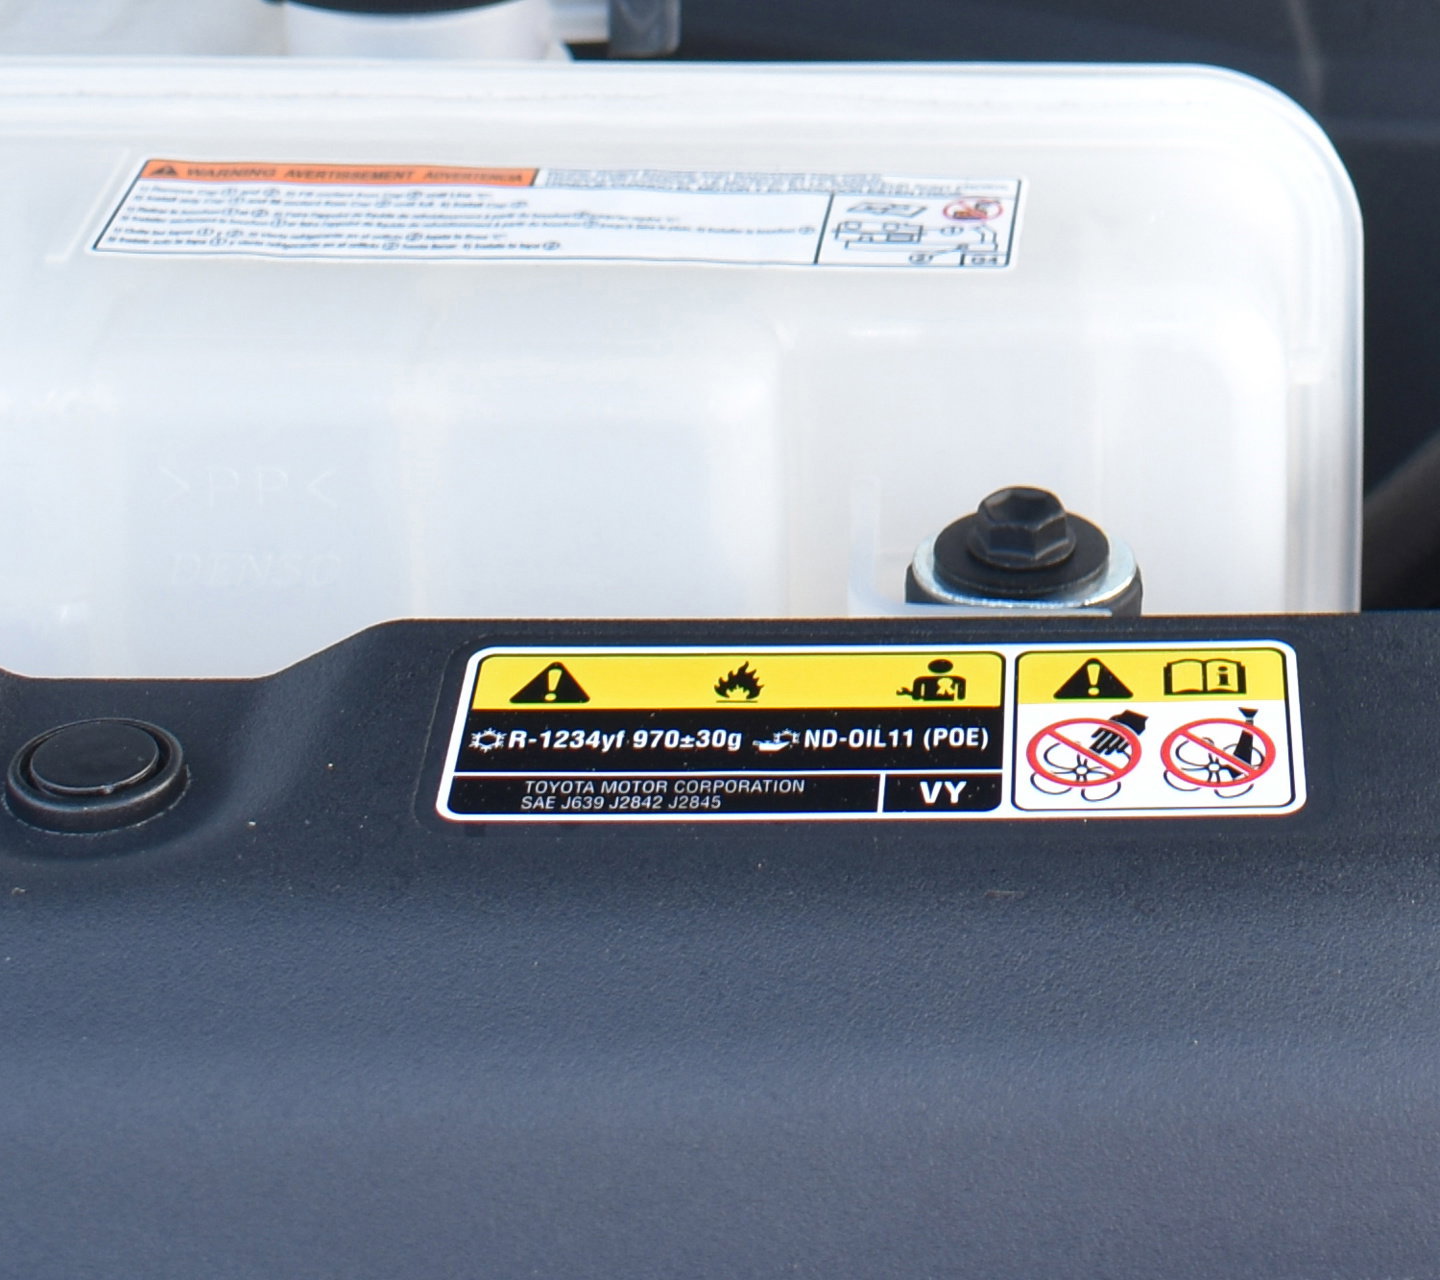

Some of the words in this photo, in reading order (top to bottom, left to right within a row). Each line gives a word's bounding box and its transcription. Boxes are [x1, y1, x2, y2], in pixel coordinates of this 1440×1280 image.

[508, 729, 626, 753] R-1234yf
[631, 728, 743, 752] 970±30g
[803, 728, 914, 749] ND-OIL11
[923, 726, 989, 751] (POE)
[525, 779, 595, 795] TOYOTA
[600, 779, 668, 794] MOTOR
[673, 778, 806, 794] CORPORATION
[919, 780, 968, 804] VY
[520, 795, 557, 810] SAE
[561, 795, 605, 810] J639
[609, 795, 664, 810] J2842
[668, 795, 723, 810] J2845
